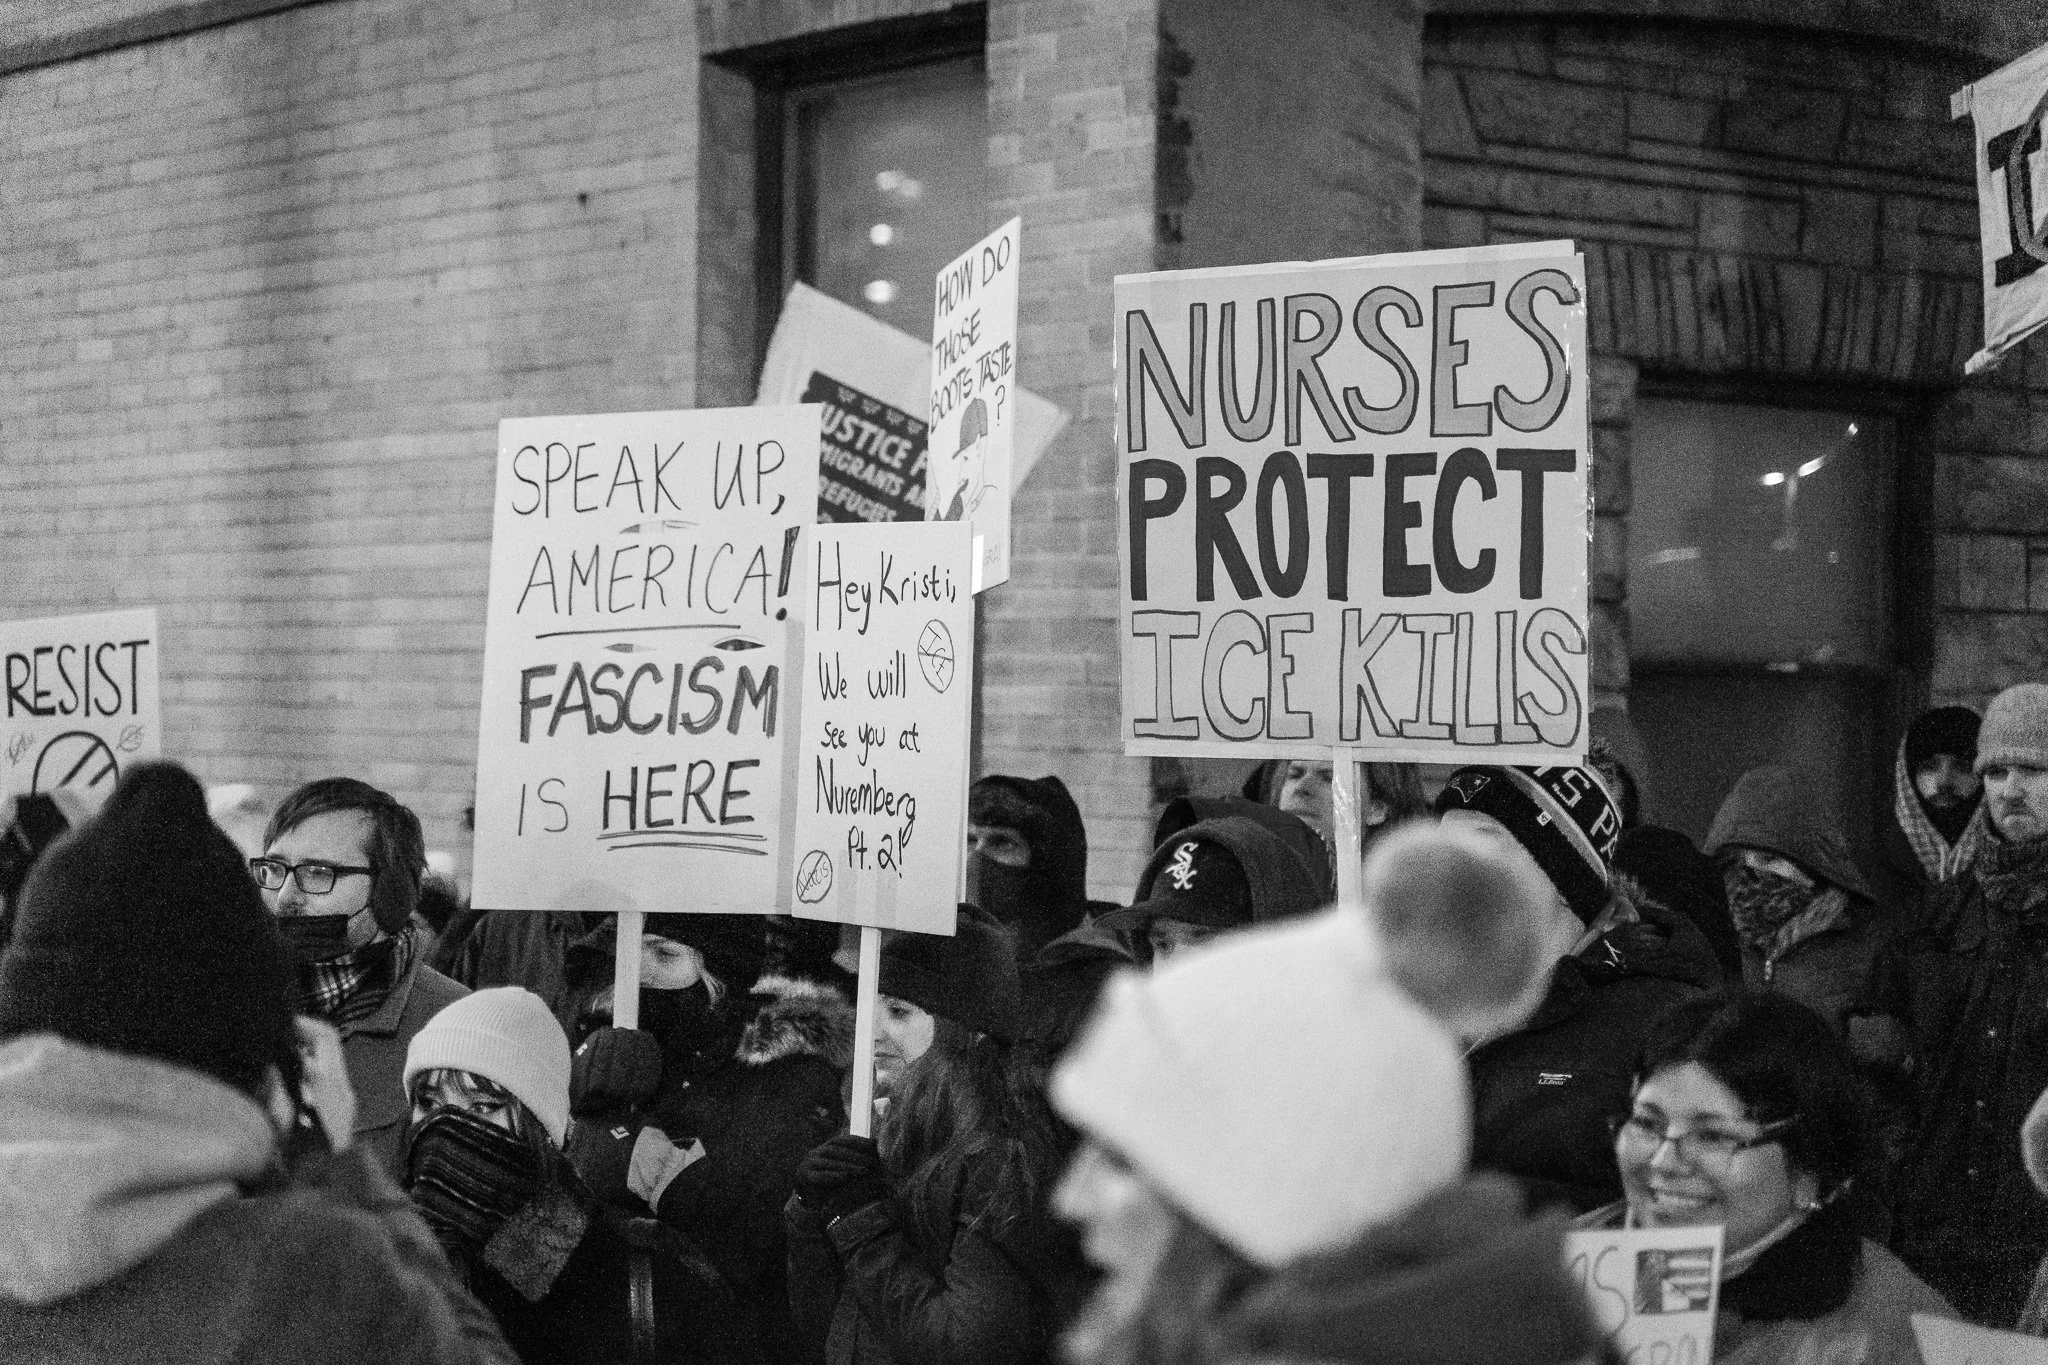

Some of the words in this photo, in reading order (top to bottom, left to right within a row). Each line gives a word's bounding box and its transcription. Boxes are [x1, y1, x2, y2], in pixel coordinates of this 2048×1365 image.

[937, 256, 974, 318] HOW
[982, 235, 1011, 288] DO
[935, 307, 981, 377] THOSE
[1126, 267, 1582, 453] NURSES
[929, 366, 973, 436] BOOTS
[975, 340, 1013, 393] TASTE
[820, 401, 914, 471] USTICE
[511, 441, 685, 518] SPEAK
[713, 439, 786, 516] UP,
[1128, 446, 1578, 603] PROTECT
[516, 525, 801, 622] AMERICA!
[816, 540, 872, 636] Hey
[878, 550, 957, 606] Kristi,
[5, 639, 150, 718] RESIST
[518, 655, 780, 744] FASCISM
[818, 650, 848, 702] We
[867, 648, 906, 700] will
[1131, 608, 1315, 743] ICE
[1338, 606, 1588, 749] KILLS
[857, 722, 886, 767] you
[899, 722, 921, 754] at
[517, 777, 569, 837] IS
[601, 758, 761, 831] HERE
[816, 754, 916, 849] Nuremberg
[848, 825, 873, 871] Pt.
[877, 826, 904, 879] 2!
